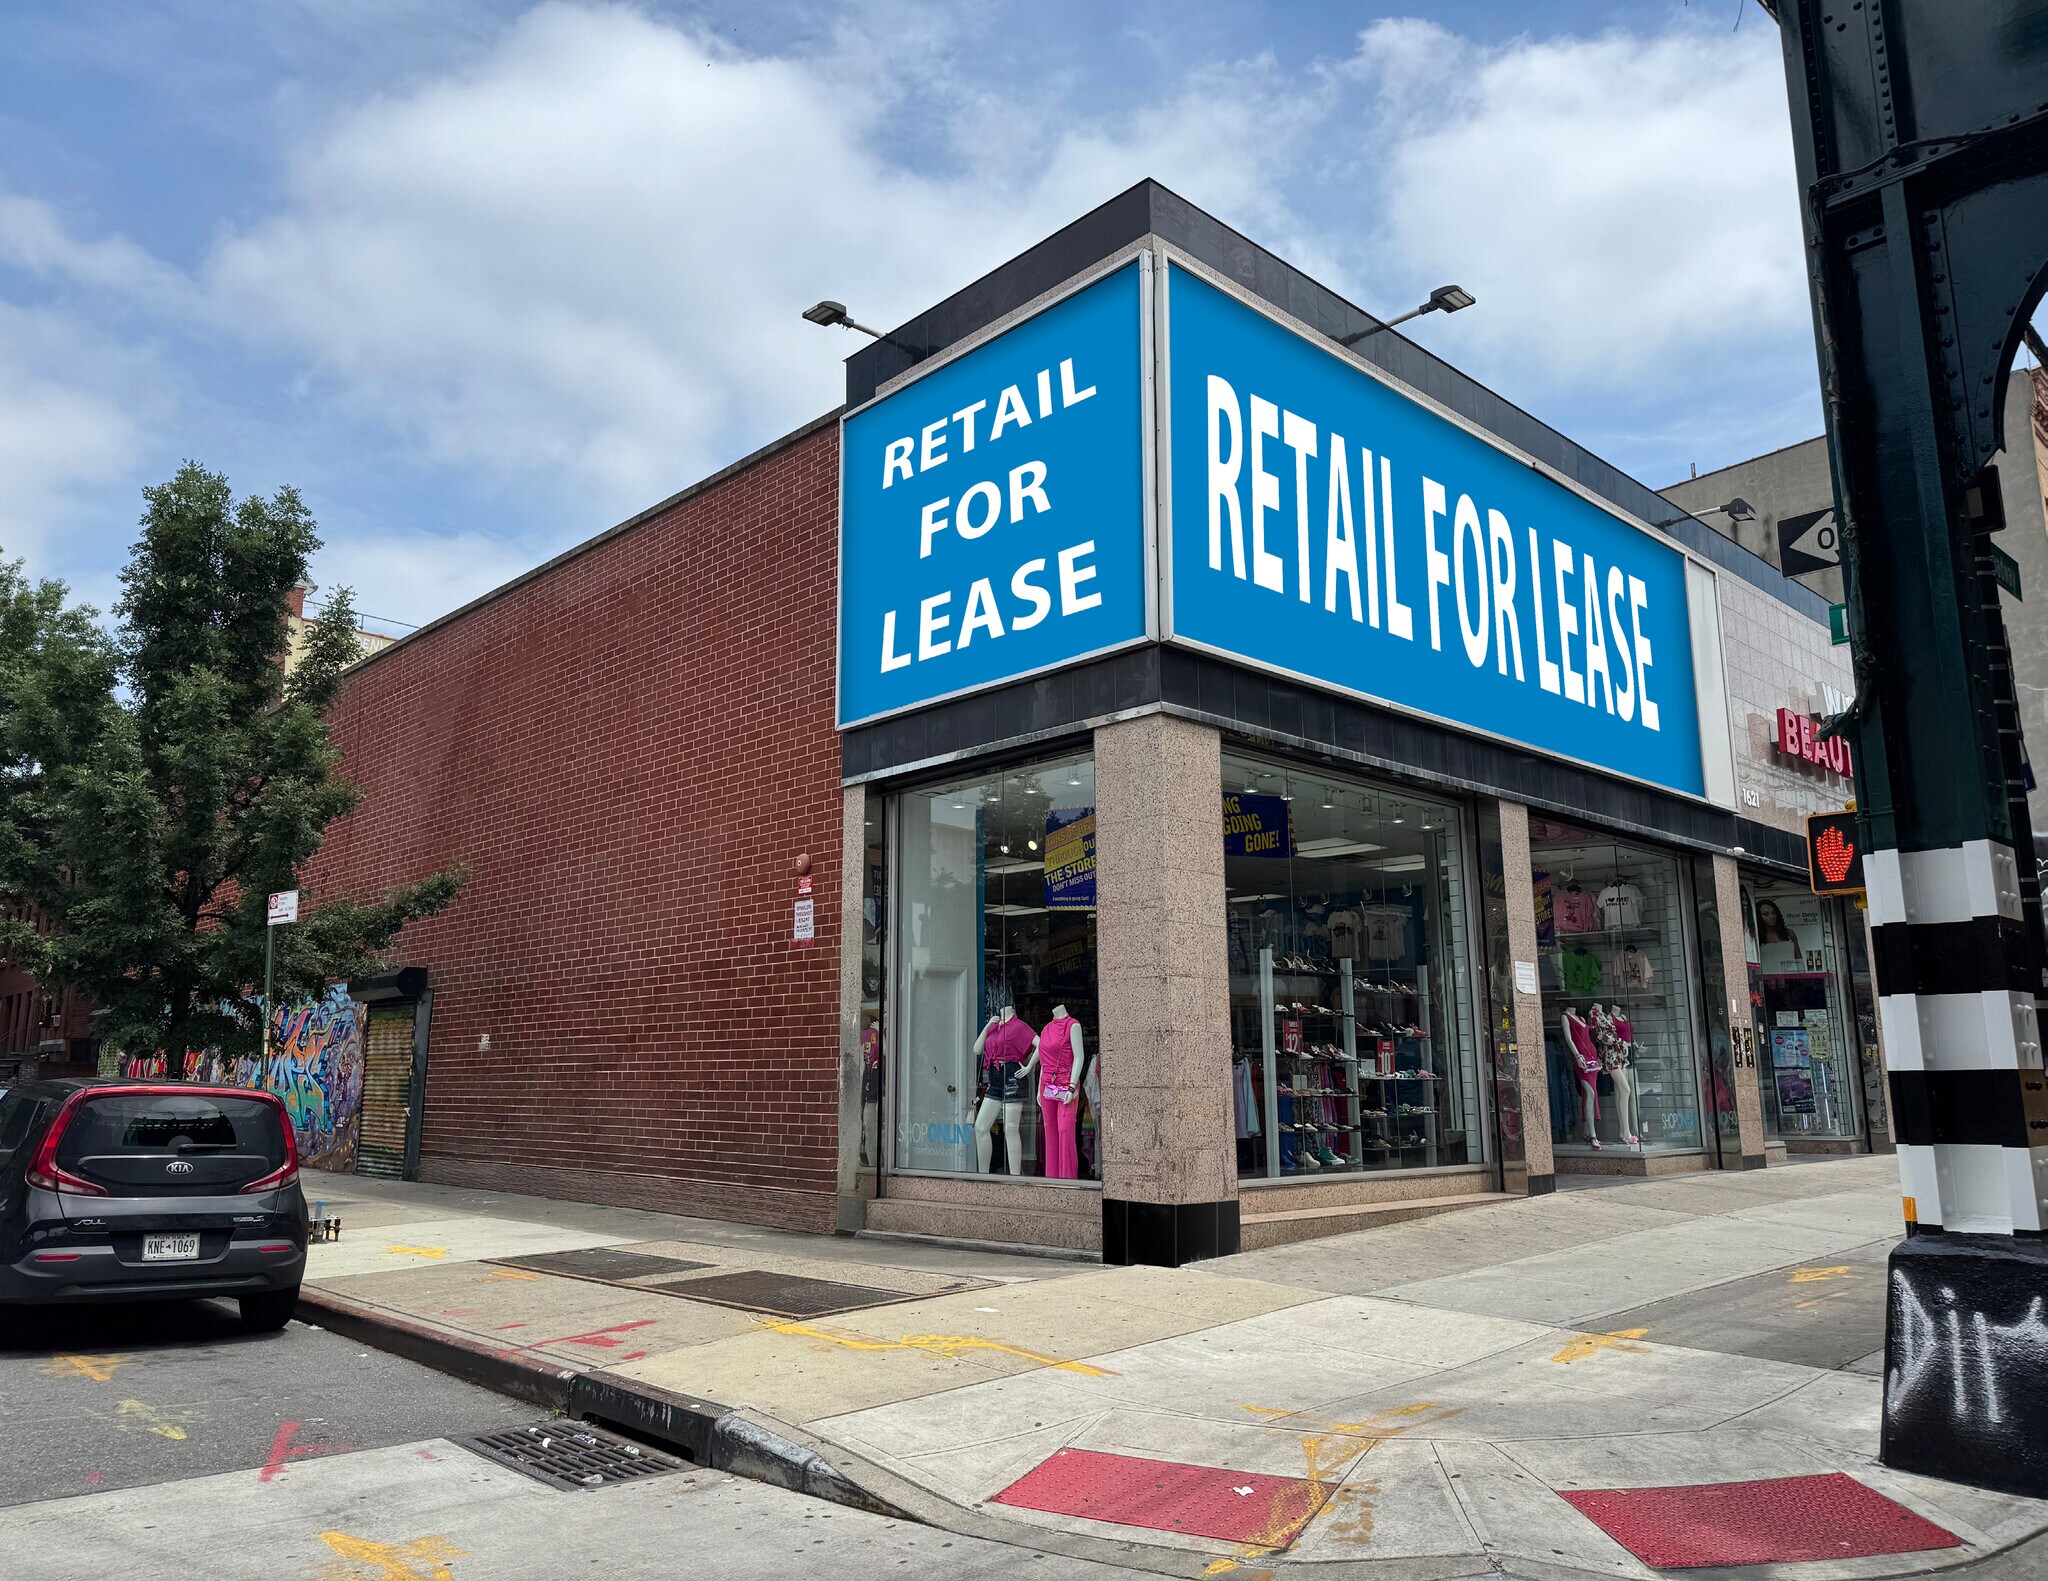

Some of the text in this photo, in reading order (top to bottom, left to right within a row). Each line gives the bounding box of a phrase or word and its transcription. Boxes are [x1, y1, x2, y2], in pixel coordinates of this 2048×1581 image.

[884, 358, 1097, 489] RETAIL
[920, 461, 1051, 559] FOR
[1207, 375, 1660, 731] RETAIL FOR LEASE
[881, 541, 1102, 673] LEASE
[1742, 787, 1760, 808] 1621
[1223, 813, 1262, 835] GOING
[1245, 830, 1280, 853] GONE!
[1045, 855, 1096, 886] THE STORE
[1053, 879, 1069, 893] DON'T
[1069, 875, 1084, 887] MISS
[170, 1164, 190, 1173] KIA
[73, 1218, 106, 1226] SOUL
